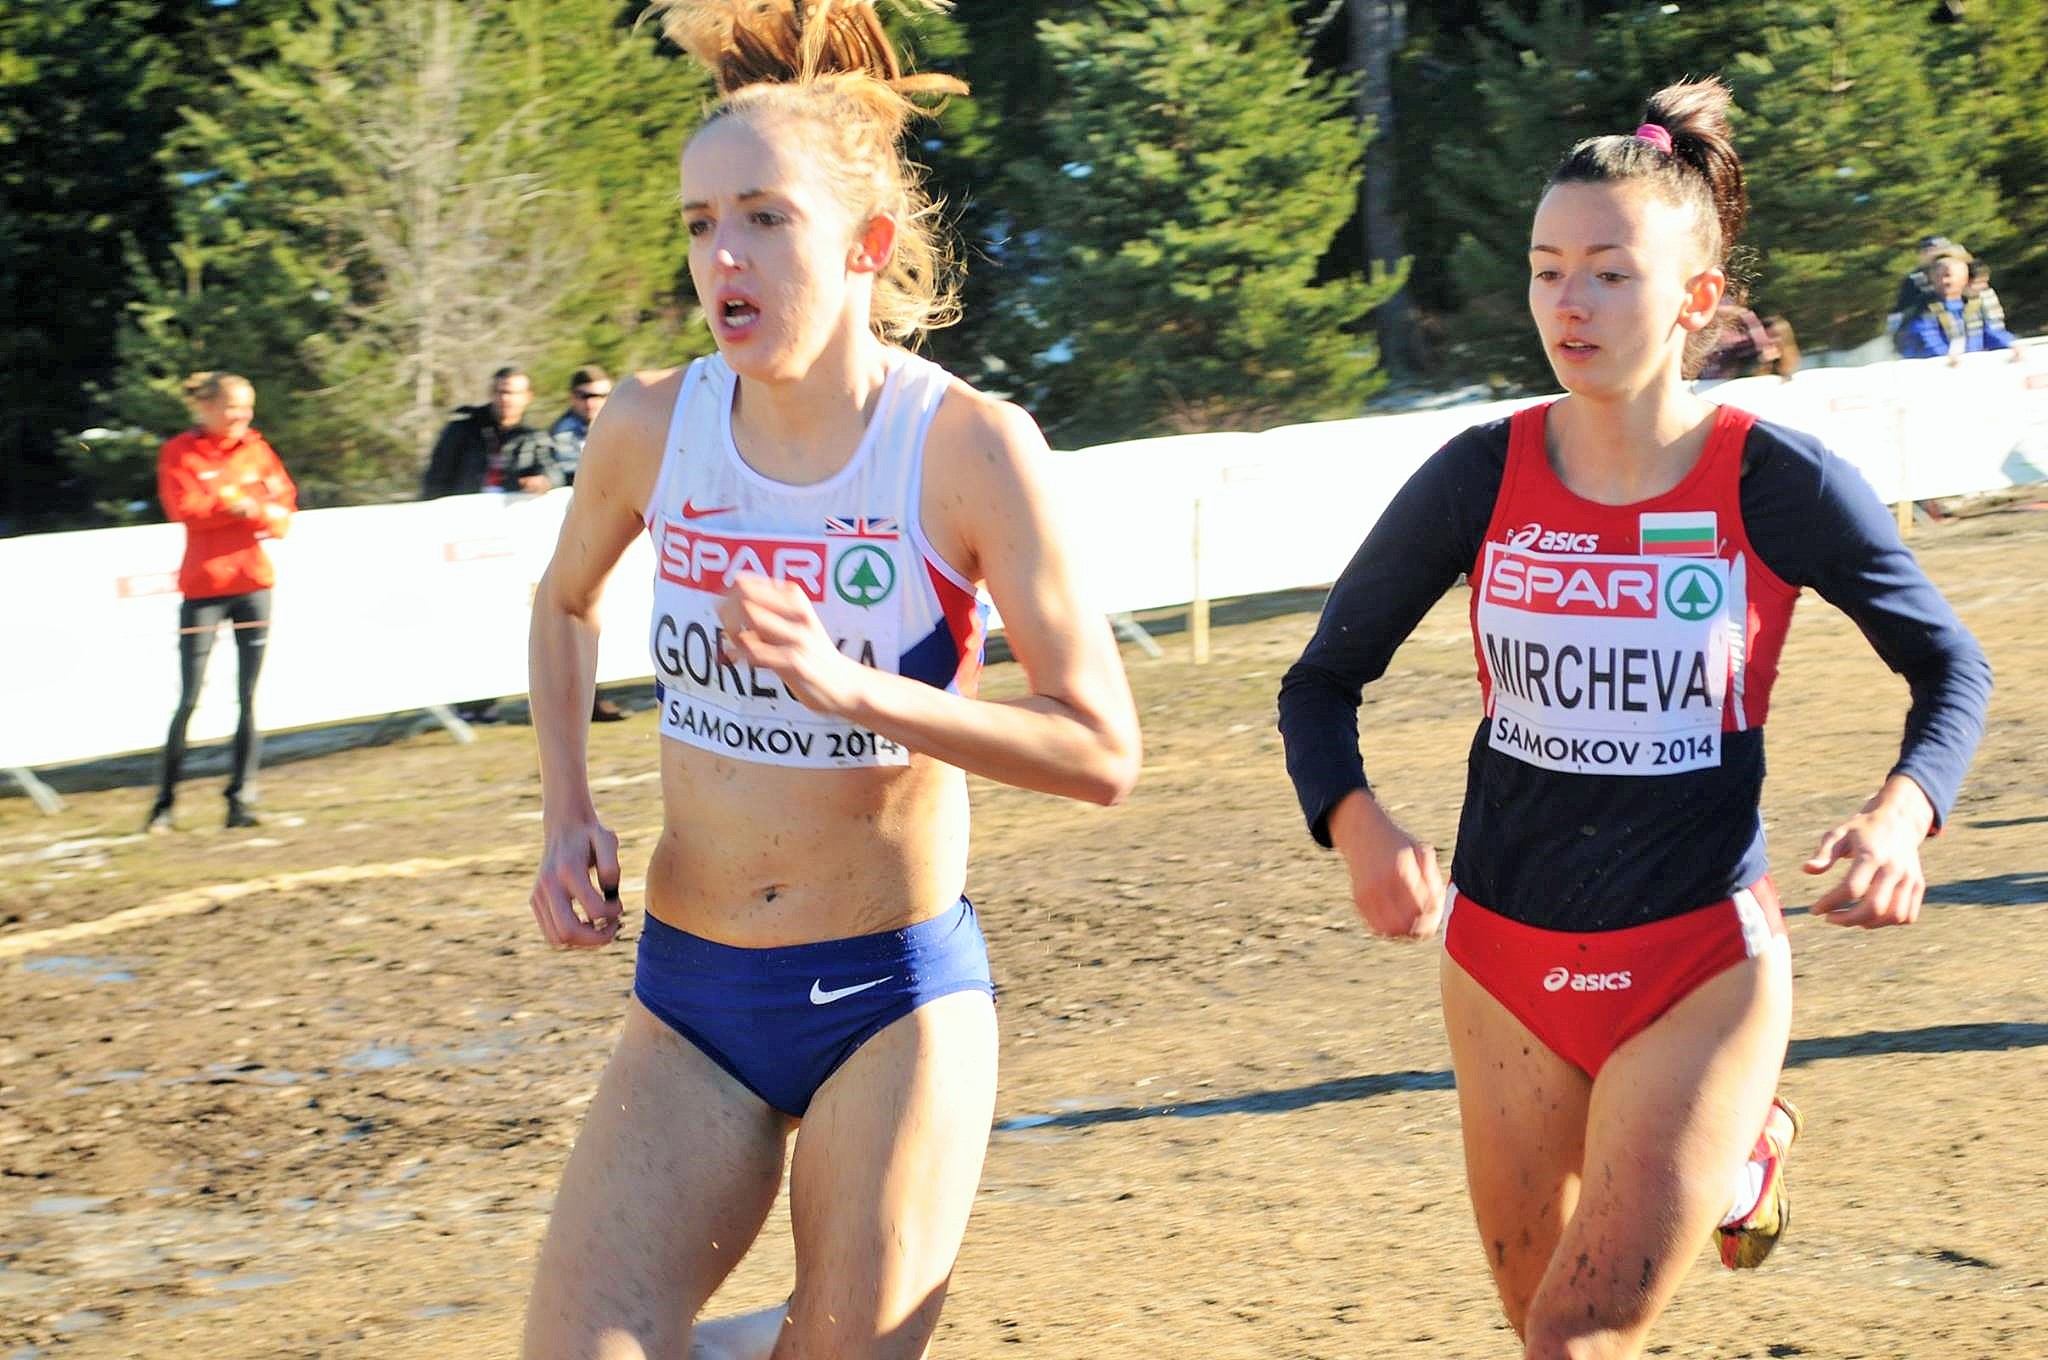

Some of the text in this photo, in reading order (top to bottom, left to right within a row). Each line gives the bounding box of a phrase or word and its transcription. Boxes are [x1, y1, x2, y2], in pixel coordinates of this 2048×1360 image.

[661, 530, 823, 595] SPAR
[1538, 530, 1600, 553] asics
[1489, 559, 1655, 611] SPAR
[1486, 633, 1713, 712] MIRCHEVA
[667, 699, 814, 757] SAMOKOV
[1495, 717, 1715, 766] SAMOKOV 2014
[1570, 970, 1632, 992] asics
